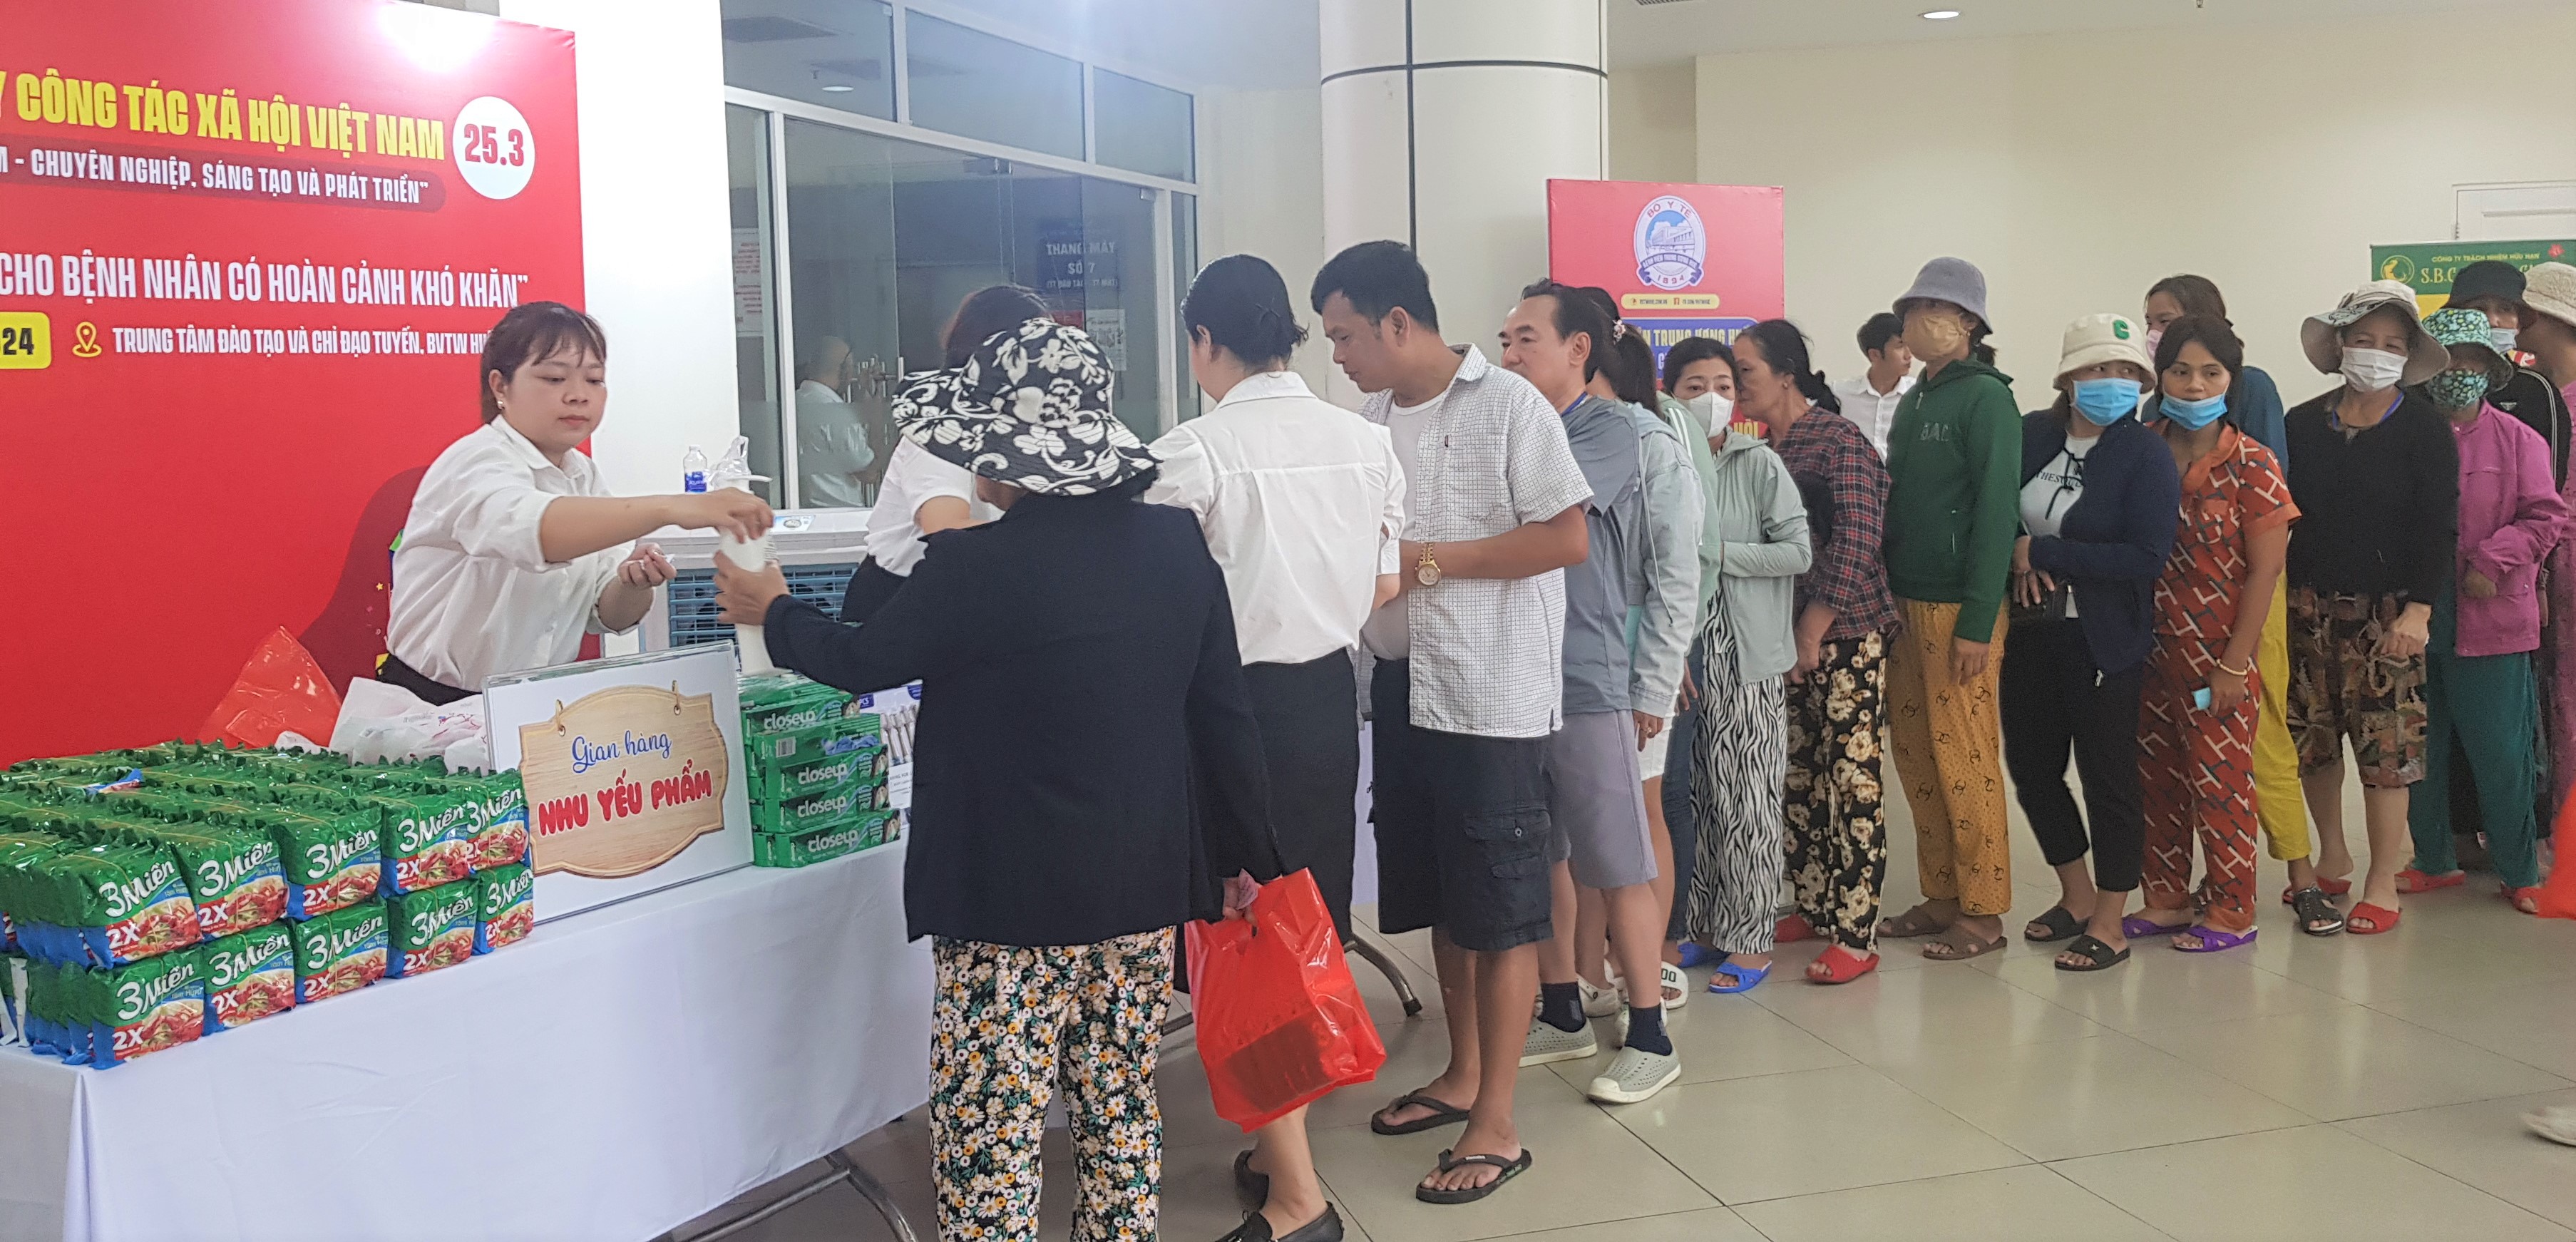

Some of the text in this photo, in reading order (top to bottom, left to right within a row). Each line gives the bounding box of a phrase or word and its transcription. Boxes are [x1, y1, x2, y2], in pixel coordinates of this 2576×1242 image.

[16, 68, 118, 128] CÔNG
[123, 80, 189, 135] TÁC
[195, 88, 242, 140] XÃ
[248, 95, 301, 152] HỘI
[307, 103, 369, 158] VIỆT
[376, 113, 445, 160] NAM
[464, 123, 524, 167] 25.3
[31, 149, 113, 180] CHUYÊN
[202, 160, 253, 190] SÁNG
[258, 168, 292, 197] TẠO
[297, 168, 320, 196] VÀ
[325, 171, 368, 200] PHÁT
[0, 252, 53, 296] CHO
[61, 249, 137, 304] BỆNH
[143, 253, 222, 300] NHÂN
[228, 255, 261, 302] CÓ
[268, 258, 335, 303] HOÀN
[342, 260, 405, 305] CẢNH
[411, 265, 453, 307] KHÓ
[0, 327, 34, 356] 24
[112, 327, 173, 354] TRUNG
[176, 324, 215, 354] TÂM
[217, 324, 251, 354] ĐÀO
[254, 326, 284, 358] TẠO
[287, 325, 309, 354] VÀ
[312, 325, 337, 354] CHỈ
[340, 330, 371, 358] ĐẠO
[427, 332, 467, 354] BVTW
[470, 330, 493, 354] HU
[572, 730, 672, 774] Gian hàng
[798, 763, 848, 785] closeup
[538, 759, 712, 836] NHU YẾU PHẨM
[797, 796, 847, 818] closeup
[808, 829, 858, 853] closeup
[396, 858, 419, 880] 2X
[302, 885, 331, 907] 2X
[198, 903, 229, 927] 2X
[106, 923, 140, 950] 2X
[486, 919, 502, 940] 2X
[404, 950, 429, 971] 2X
[304, 973, 331, 997] 2X
[212, 990, 240, 1015] 2X
[112, 1026, 145, 1051] 2X
